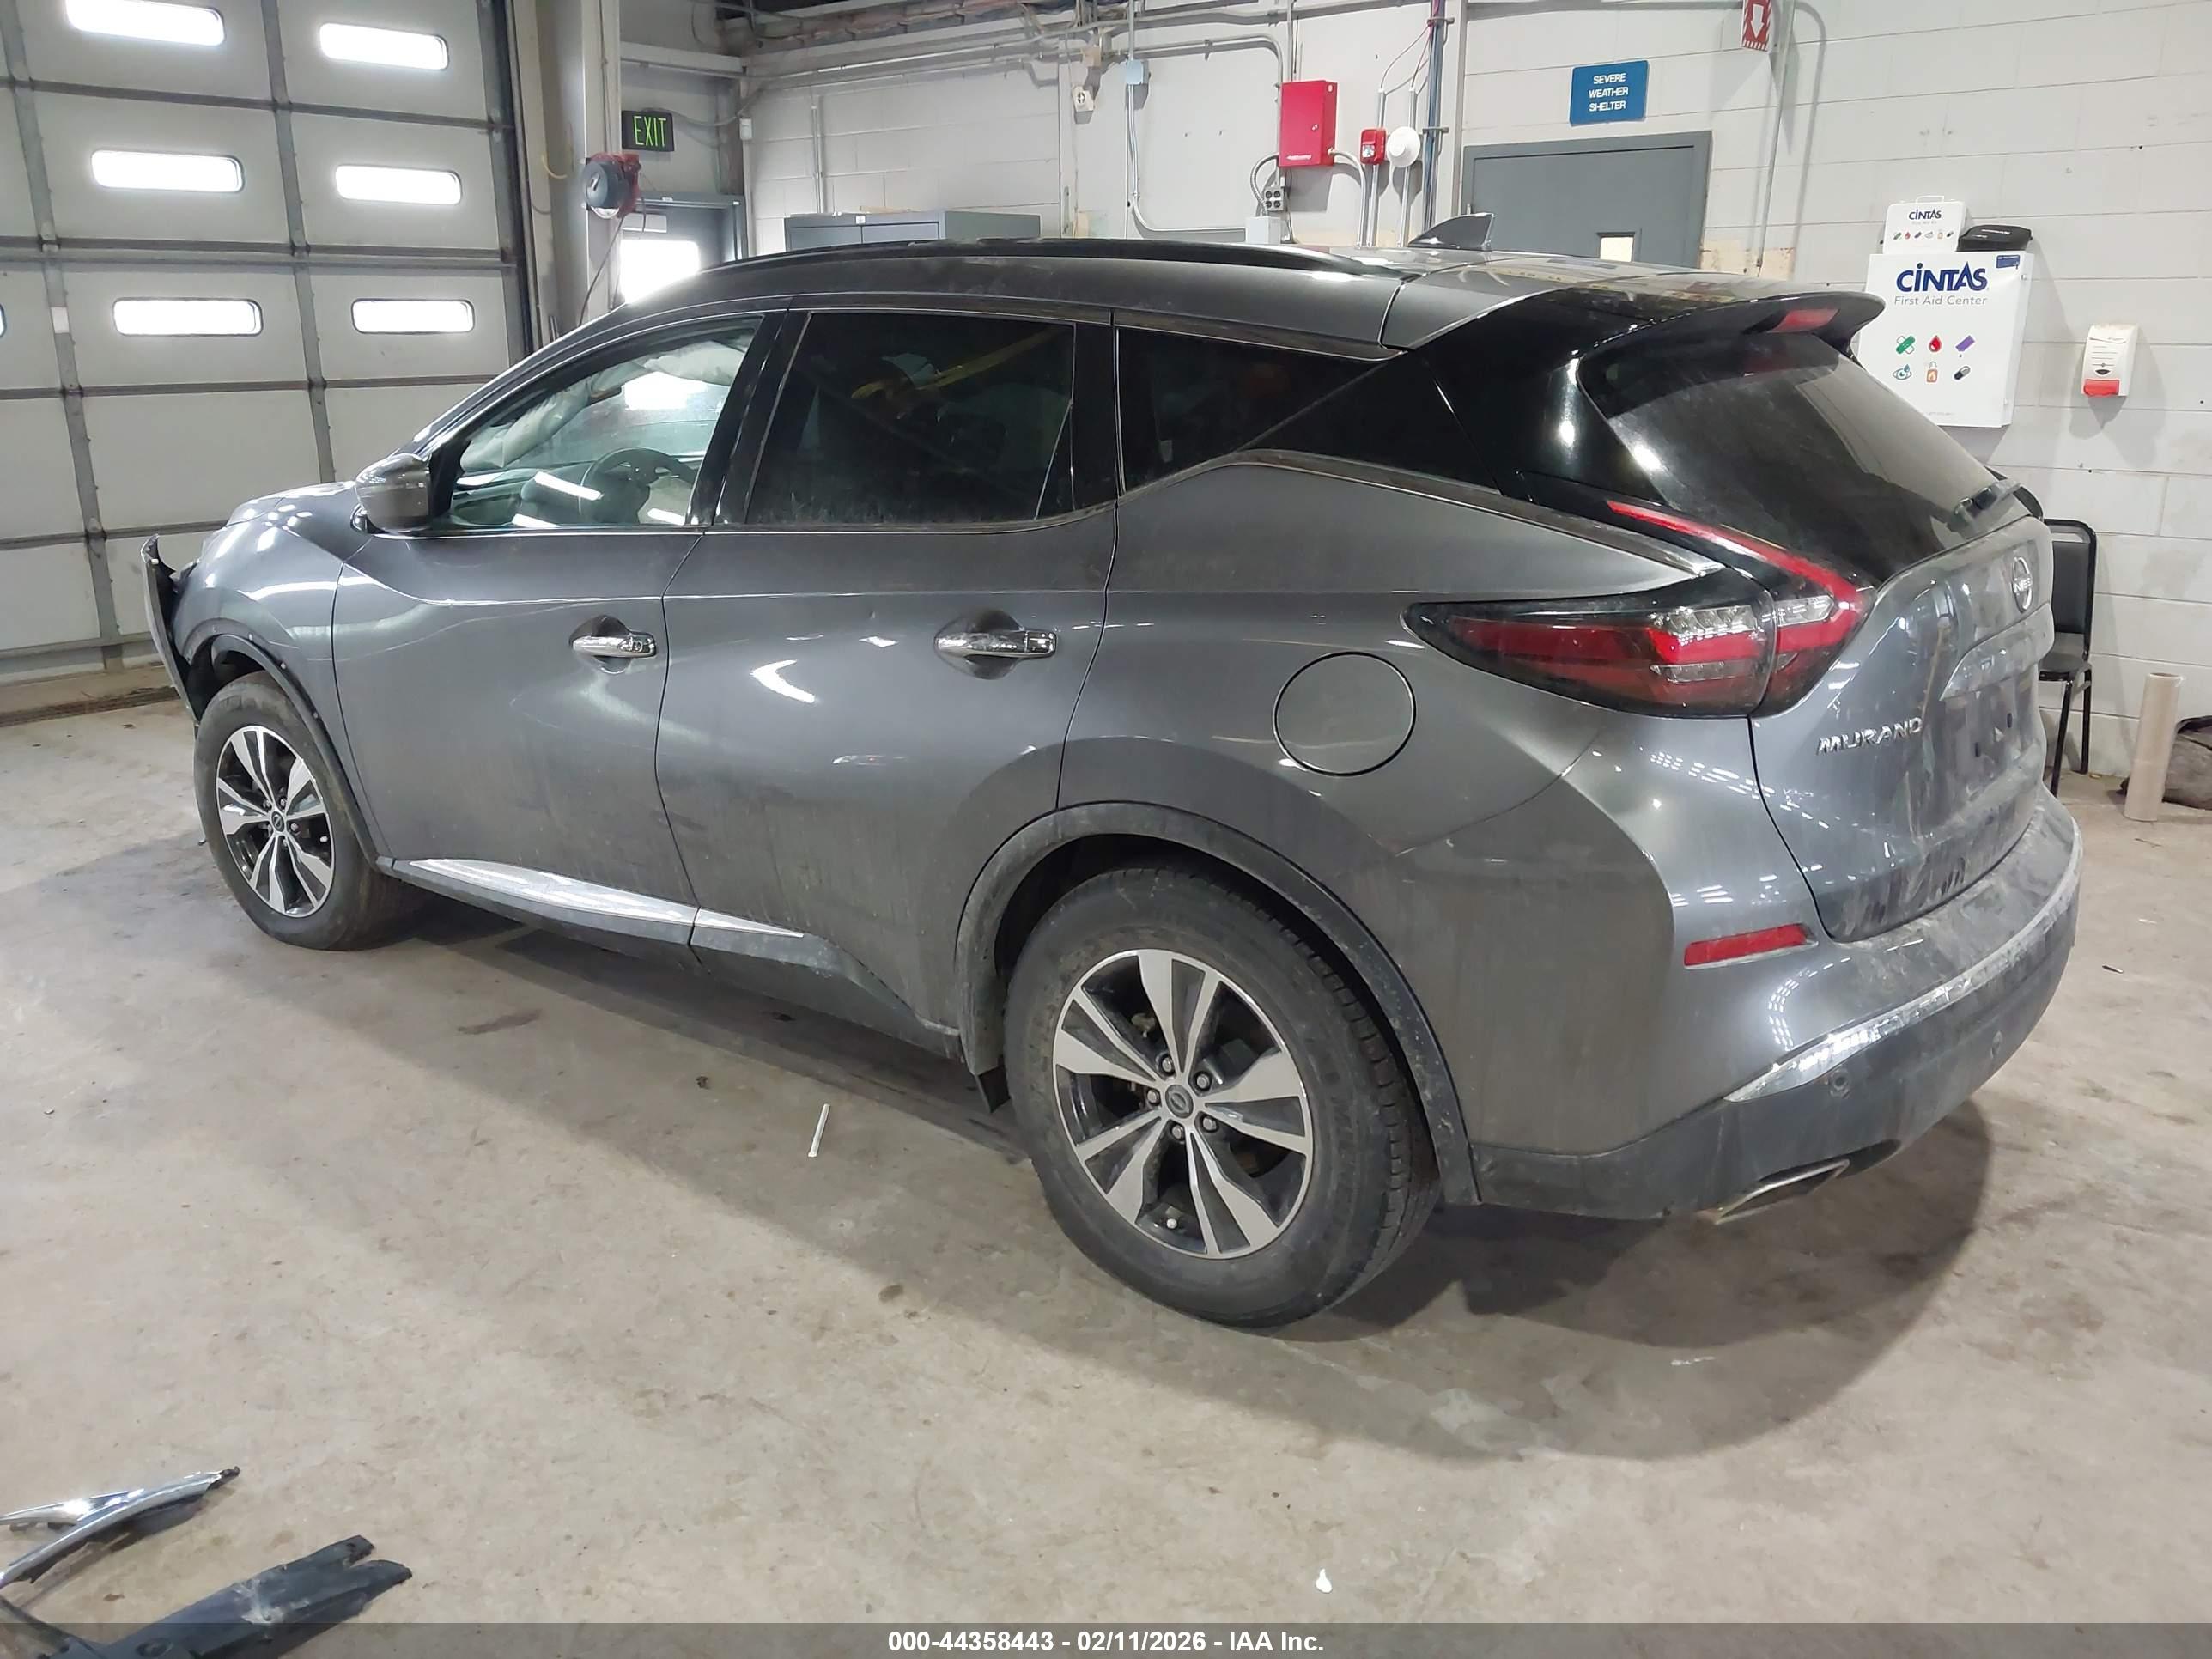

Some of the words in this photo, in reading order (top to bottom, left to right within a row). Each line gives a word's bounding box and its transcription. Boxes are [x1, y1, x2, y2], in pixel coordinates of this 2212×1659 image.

[1593, 73, 1626, 84] SEVERE
[1588, 87, 1629, 99] WEATHER
[1589, 100, 1626, 112] SHELTER
[633, 115, 667, 147] EXIT
[1894, 295, 1918, 305] First
[1923, 295, 1943, 305] Aid
[1947, 295, 1988, 305] Center
[1816, 717, 1923, 755] MURANO
